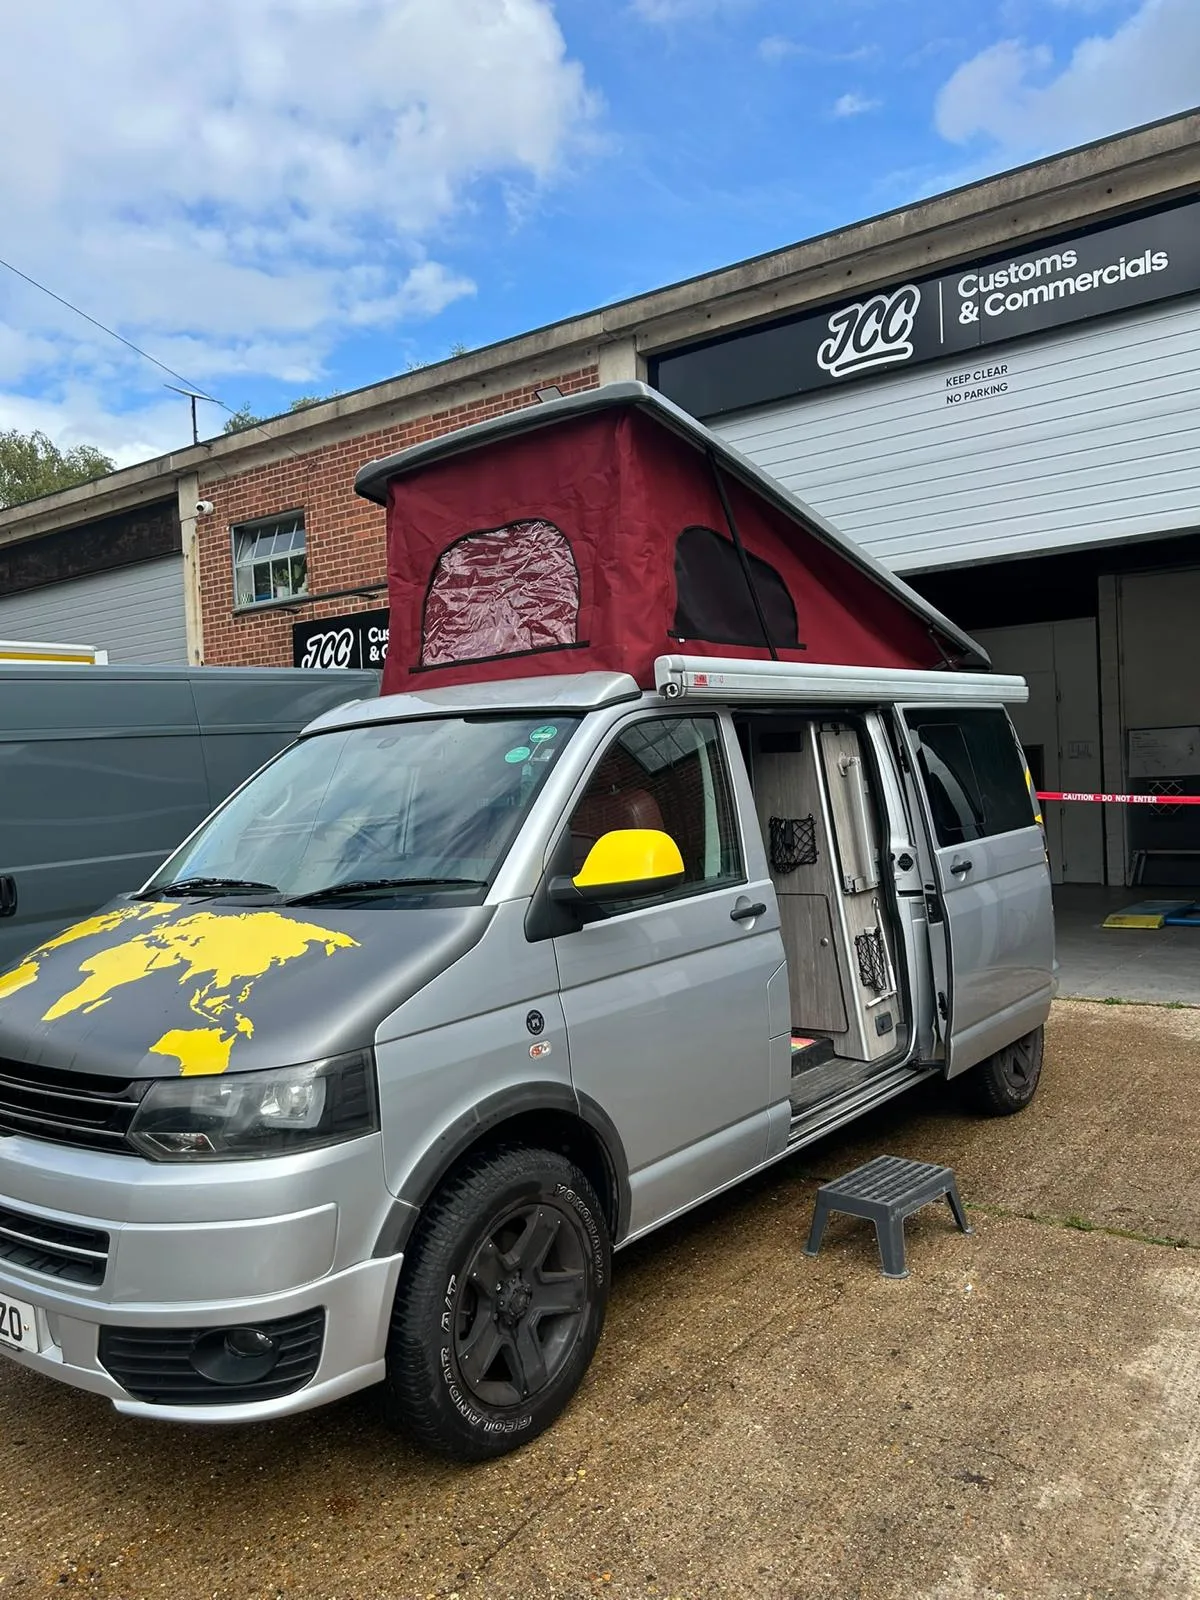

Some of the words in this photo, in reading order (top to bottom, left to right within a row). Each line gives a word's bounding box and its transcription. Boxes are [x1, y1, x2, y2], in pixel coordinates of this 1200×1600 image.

[957, 249, 1078, 298] Customs
[958, 301, 980, 325] &
[983, 249, 1169, 316] Commercials
[818, 284, 921, 376] JCC
[945, 373, 971, 387] KEEP
[973, 364, 1008, 381] CLEAR
[946, 393, 962, 404] NO
[964, 382, 1008, 401] PARKING
[301, 628, 354, 668] JCC
[1062, 793, 1094, 801] CAUTION
[1102, 794, 1113, 802] DO
[1115, 795, 1131, 803] NOT
[1133, 795, 1158, 803] ENTER
